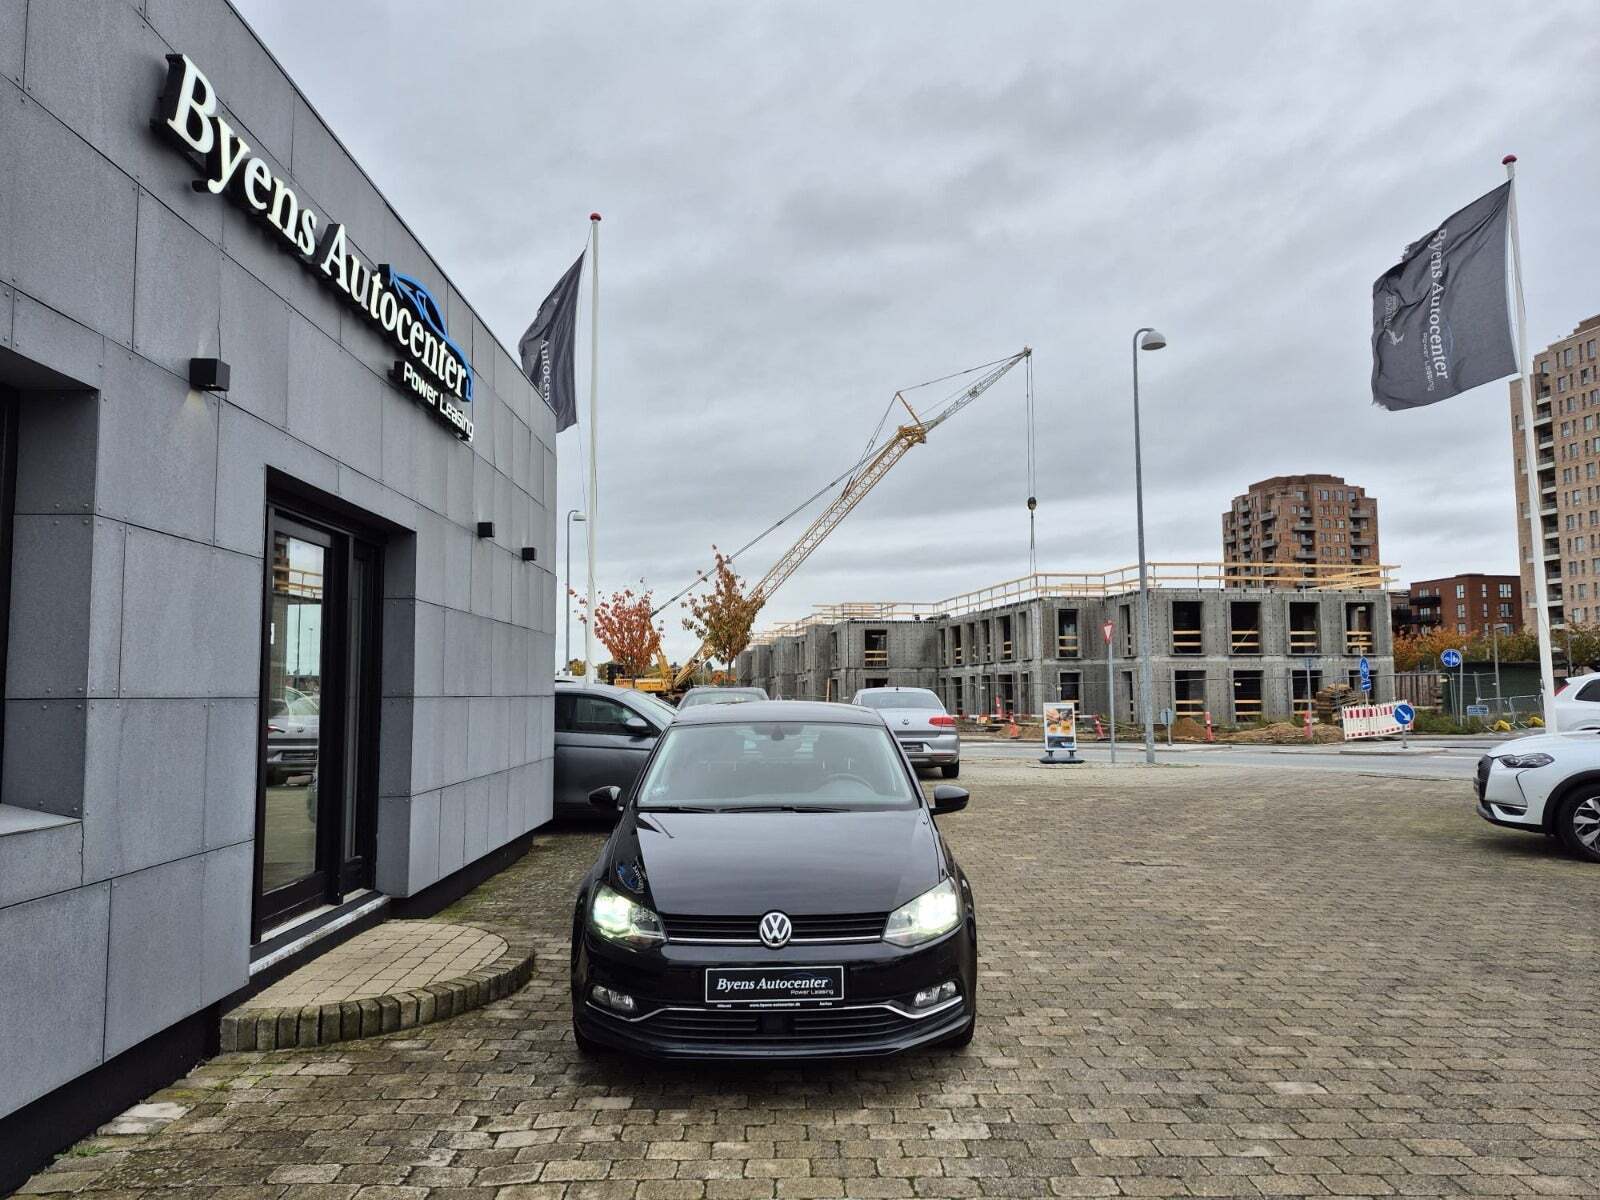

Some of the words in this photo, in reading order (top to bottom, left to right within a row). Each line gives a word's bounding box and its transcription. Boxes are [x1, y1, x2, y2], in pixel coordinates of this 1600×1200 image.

[167, 54, 317, 256] Byens
[321, 224, 467, 398] Autocenter
[1428, 228, 1447, 279] Byens
[1429, 282, 1449, 379] Autocenter
[403, 361, 438, 406] Power
[440, 393, 474, 442] Leasing
[540, 339, 551, 401] Autocen
[716, 978, 755, 992] Byens
[756, 977, 828, 990] Autocenter
